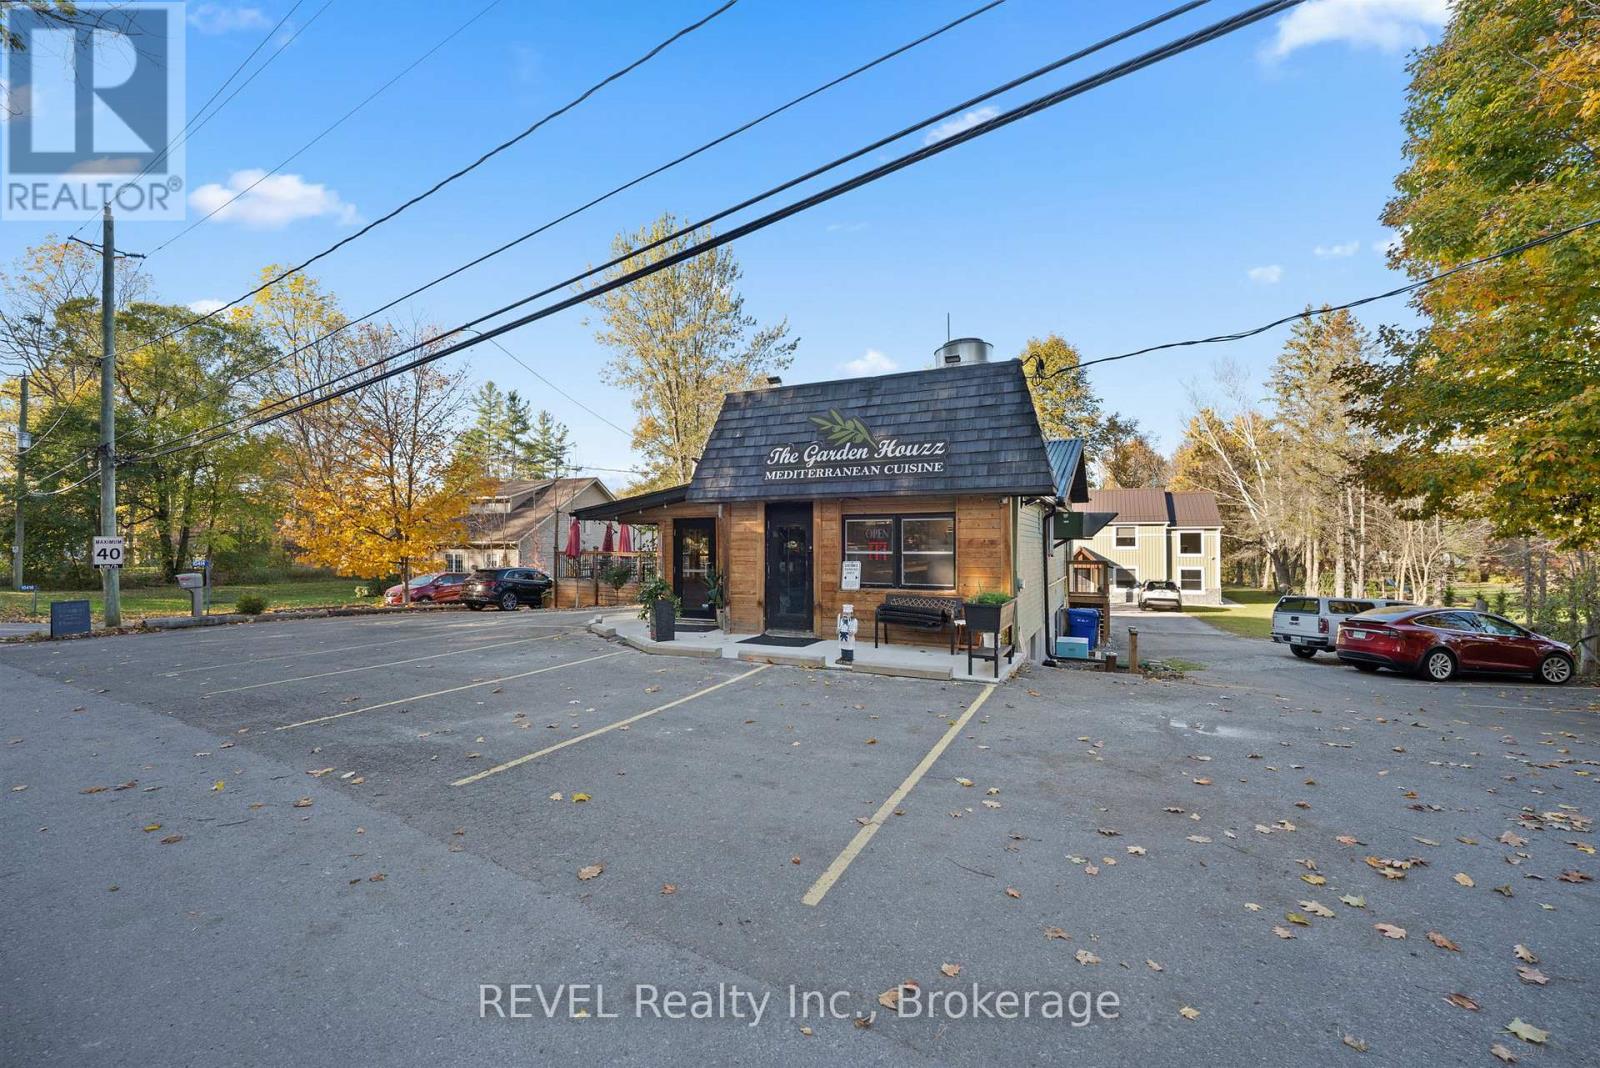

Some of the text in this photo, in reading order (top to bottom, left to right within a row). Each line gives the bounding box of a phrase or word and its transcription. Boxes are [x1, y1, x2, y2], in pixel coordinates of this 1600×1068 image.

[767, 439, 945, 467] The Garden Houzz
[765, 462, 944, 481] MEDITERRANEAN CUISINE
[865, 527, 889, 539] OPEN
[96, 547, 121, 561] 40
